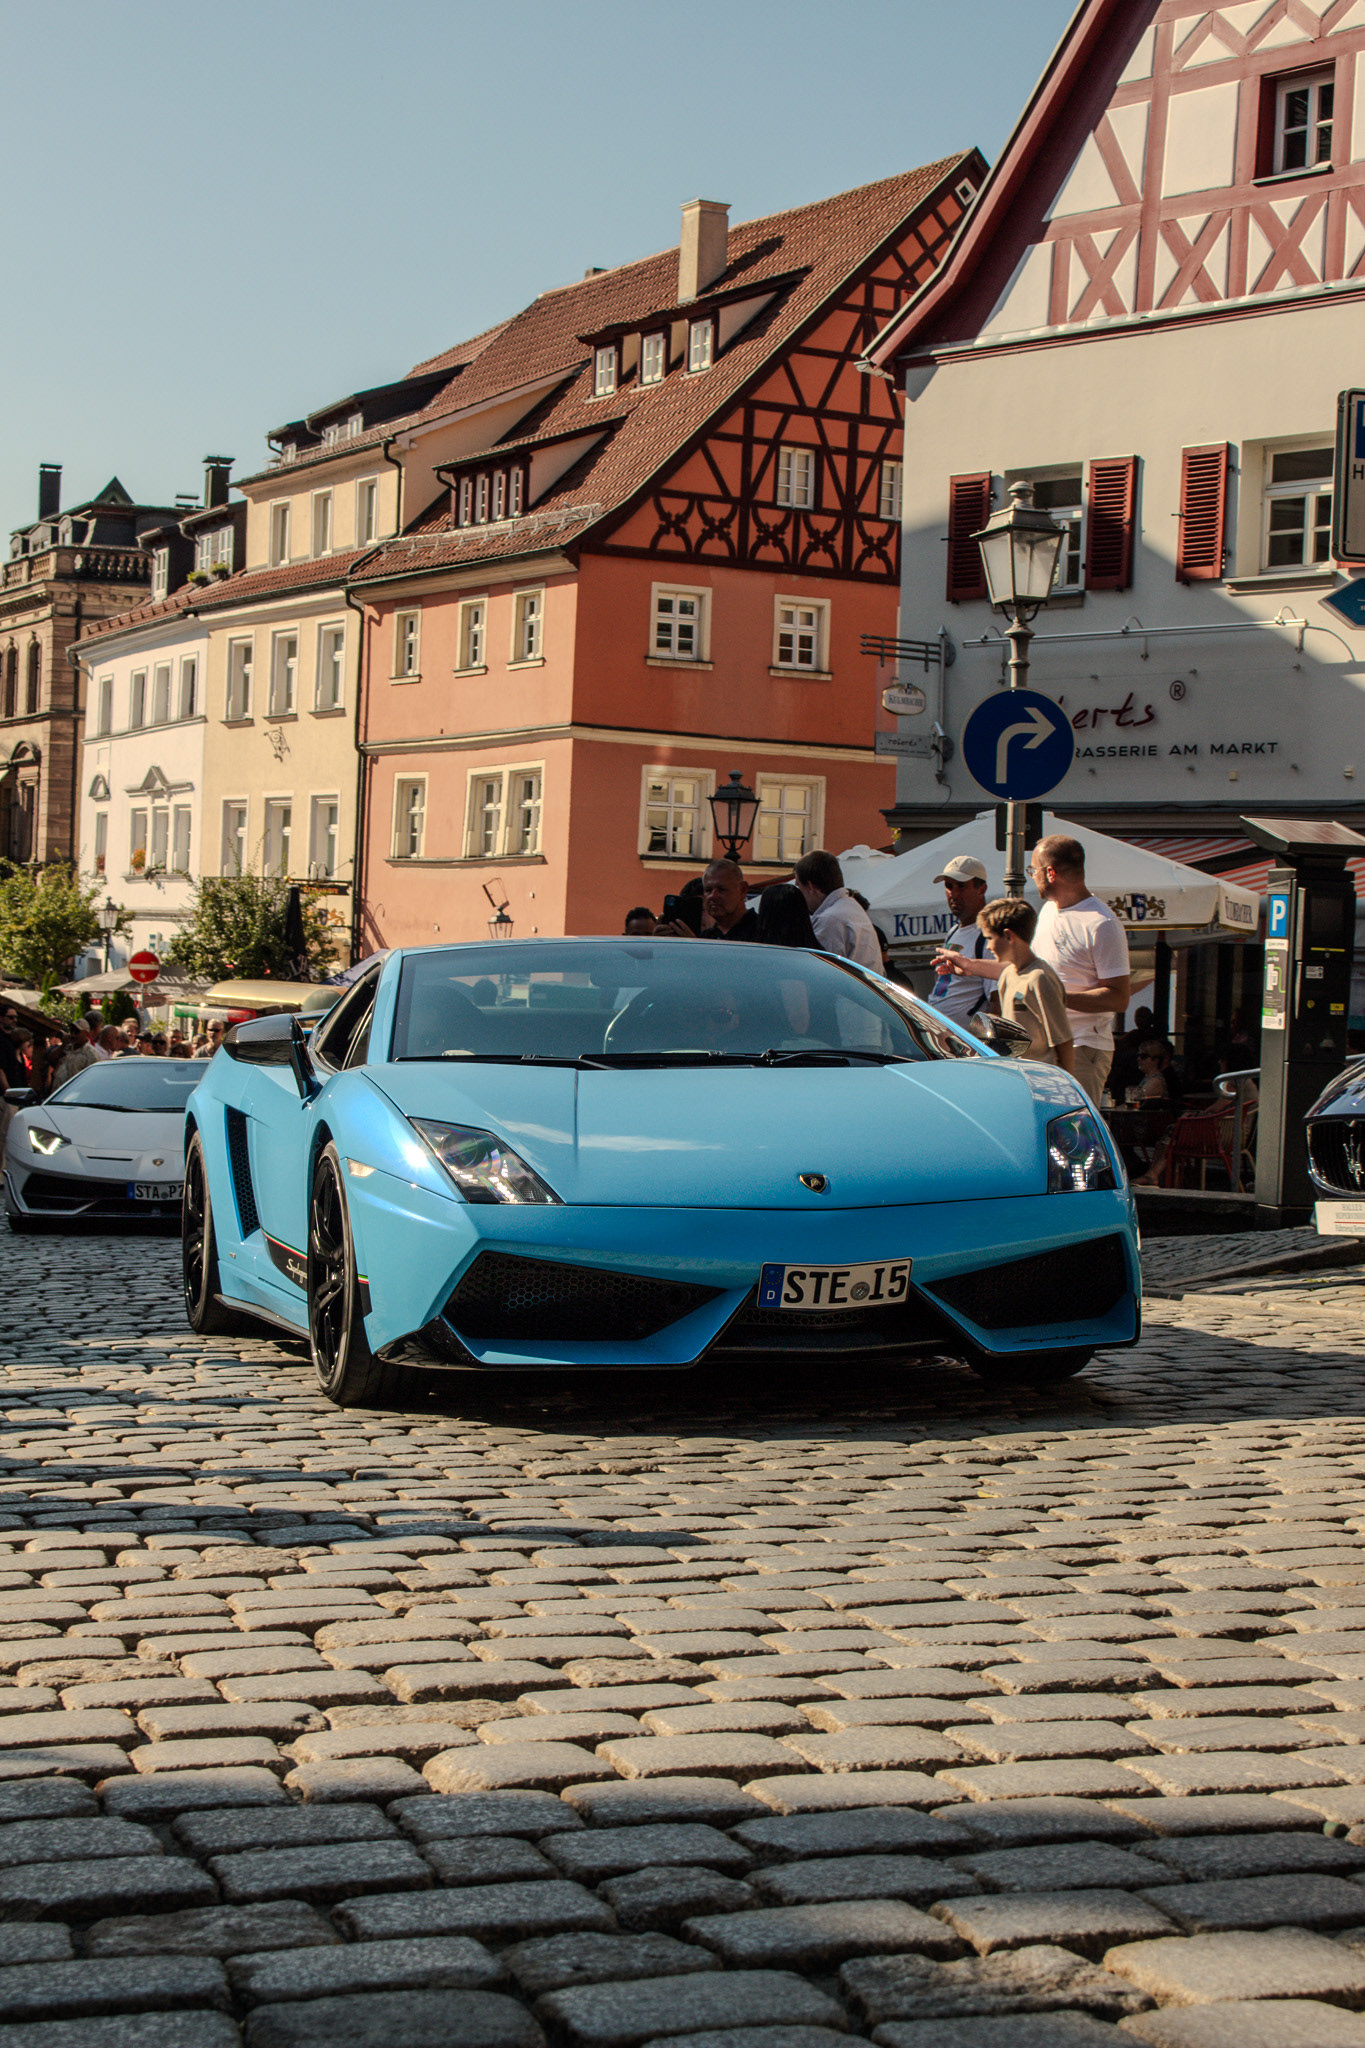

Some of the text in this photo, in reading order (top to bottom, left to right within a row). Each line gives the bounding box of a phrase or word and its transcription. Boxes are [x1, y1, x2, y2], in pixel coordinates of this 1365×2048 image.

[1057, 692, 1155, 729] erts
[1169, 744, 1198, 755] AM
[1210, 742, 1278, 755] MARKT
[1271, 899, 1286, 931] P
[136, 1184, 160, 1199] STA
[766, 1290, 775, 1300] D
[783, 1270, 850, 1304] STE
